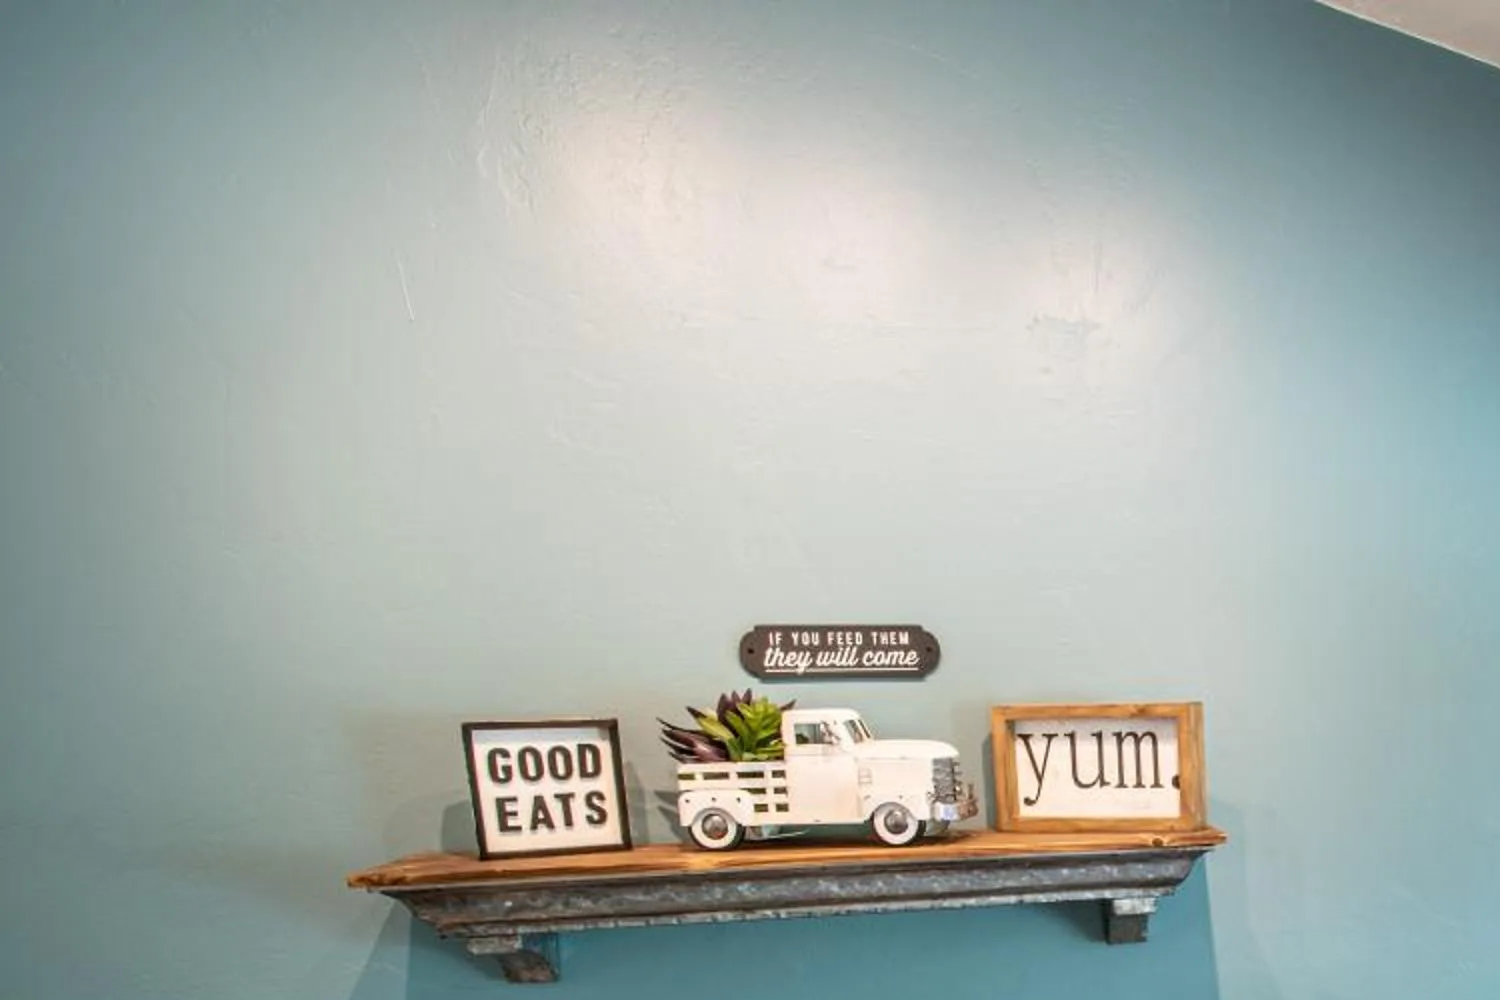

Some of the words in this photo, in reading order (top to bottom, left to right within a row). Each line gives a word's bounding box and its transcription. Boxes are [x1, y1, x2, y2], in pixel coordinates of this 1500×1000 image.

[768, 631, 783, 646] IF
[791, 631, 820, 646] YOU
[828, 631, 864, 646] FEED
[872, 631, 910, 645] THEM
[764, 647, 813, 674] they
[816, 646, 859, 667] will
[862, 648, 921, 667] come
[487, 743, 602, 784] GOOD
[1016, 729, 1181, 807] yum.
[496, 790, 608, 833] EATS
